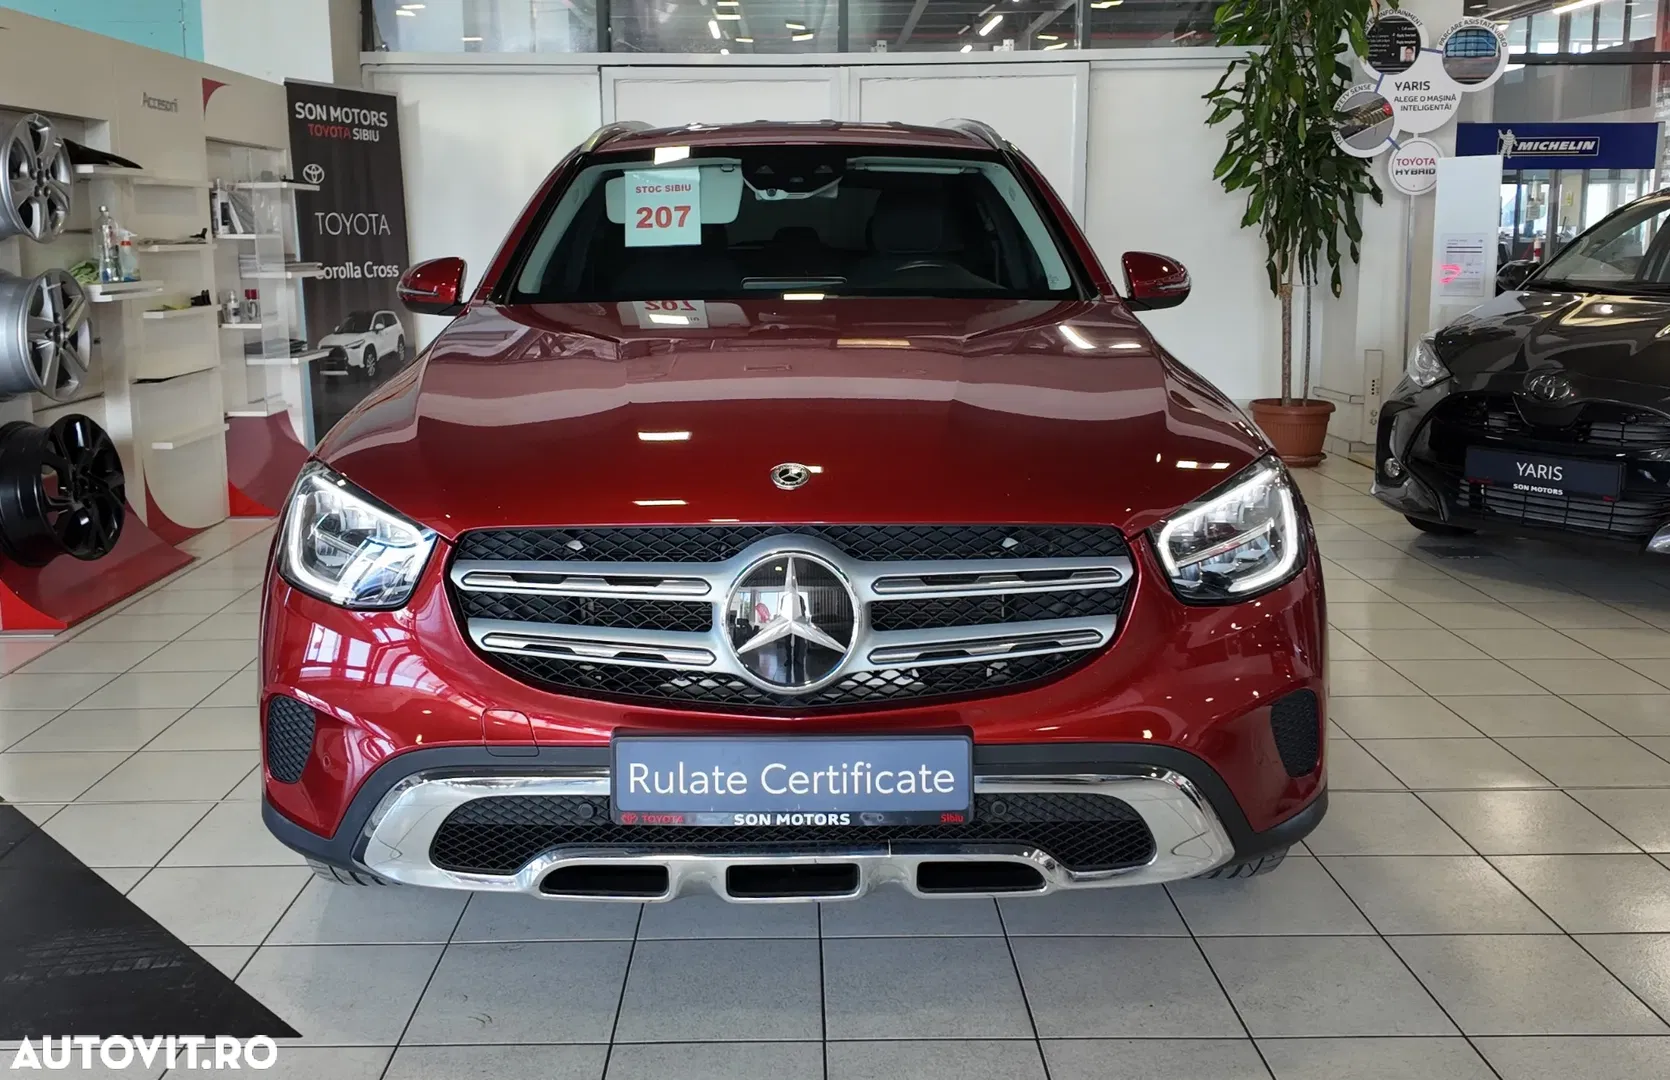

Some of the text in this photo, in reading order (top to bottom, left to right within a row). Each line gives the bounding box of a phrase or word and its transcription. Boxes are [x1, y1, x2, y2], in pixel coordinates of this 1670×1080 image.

[1439, 22, 1462, 46] PARCARE
[1494, 30, 1508, 48] VIDEO
[1394, 81, 1431, 91] YARIS
[1334, 84, 1371, 111] AFETY SENSE
[295, 102, 388, 128] SON MOTORS
[308, 124, 380, 142] TOYOTA SIBIU
[1517, 140, 1596, 151] MICHELIN
[1396, 157, 1436, 167] TOYOTA
[1395, 168, 1436, 176] HYBRID
[635, 184, 692, 194] STOC SIBIU
[314, 212, 391, 236] TOYOTA
[635, 205, 691, 229] 207
[363, 261, 400, 279] Cross
[1516, 461, 1563, 481] YARIS
[1512, 483, 1564, 496] SON MOTORS
[628, 761, 955, 795] Rulate Certificate
[641, 814, 684, 824] TOYOTA
[734, 813, 772, 826] SON
[776, 813, 851, 826] MOTORS
